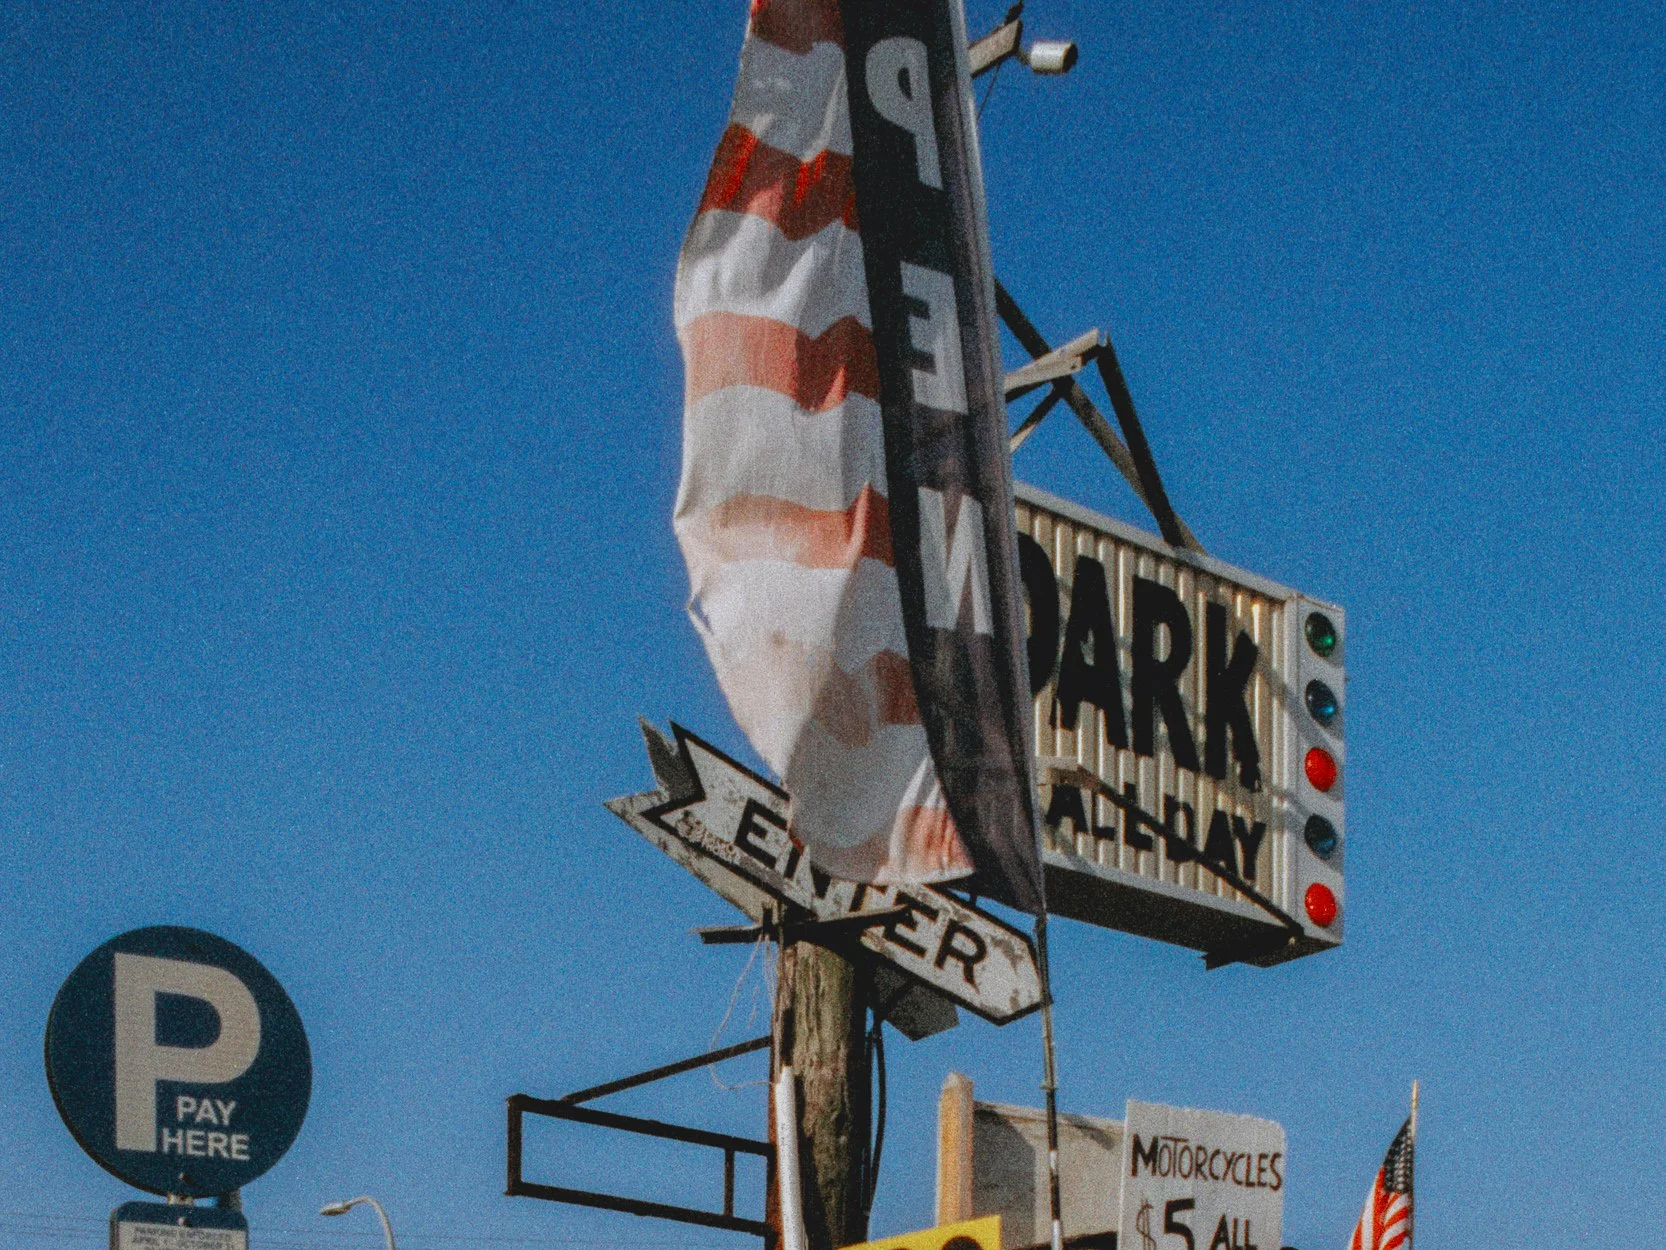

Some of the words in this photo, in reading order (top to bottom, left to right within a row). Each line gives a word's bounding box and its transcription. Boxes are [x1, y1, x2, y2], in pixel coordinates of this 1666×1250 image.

[114, 951, 261, 1152] P
[177, 1096, 236, 1127] PAY
[162, 1127, 250, 1161] HERE
[1131, 1133, 1283, 1192] MOTORCYCLES
